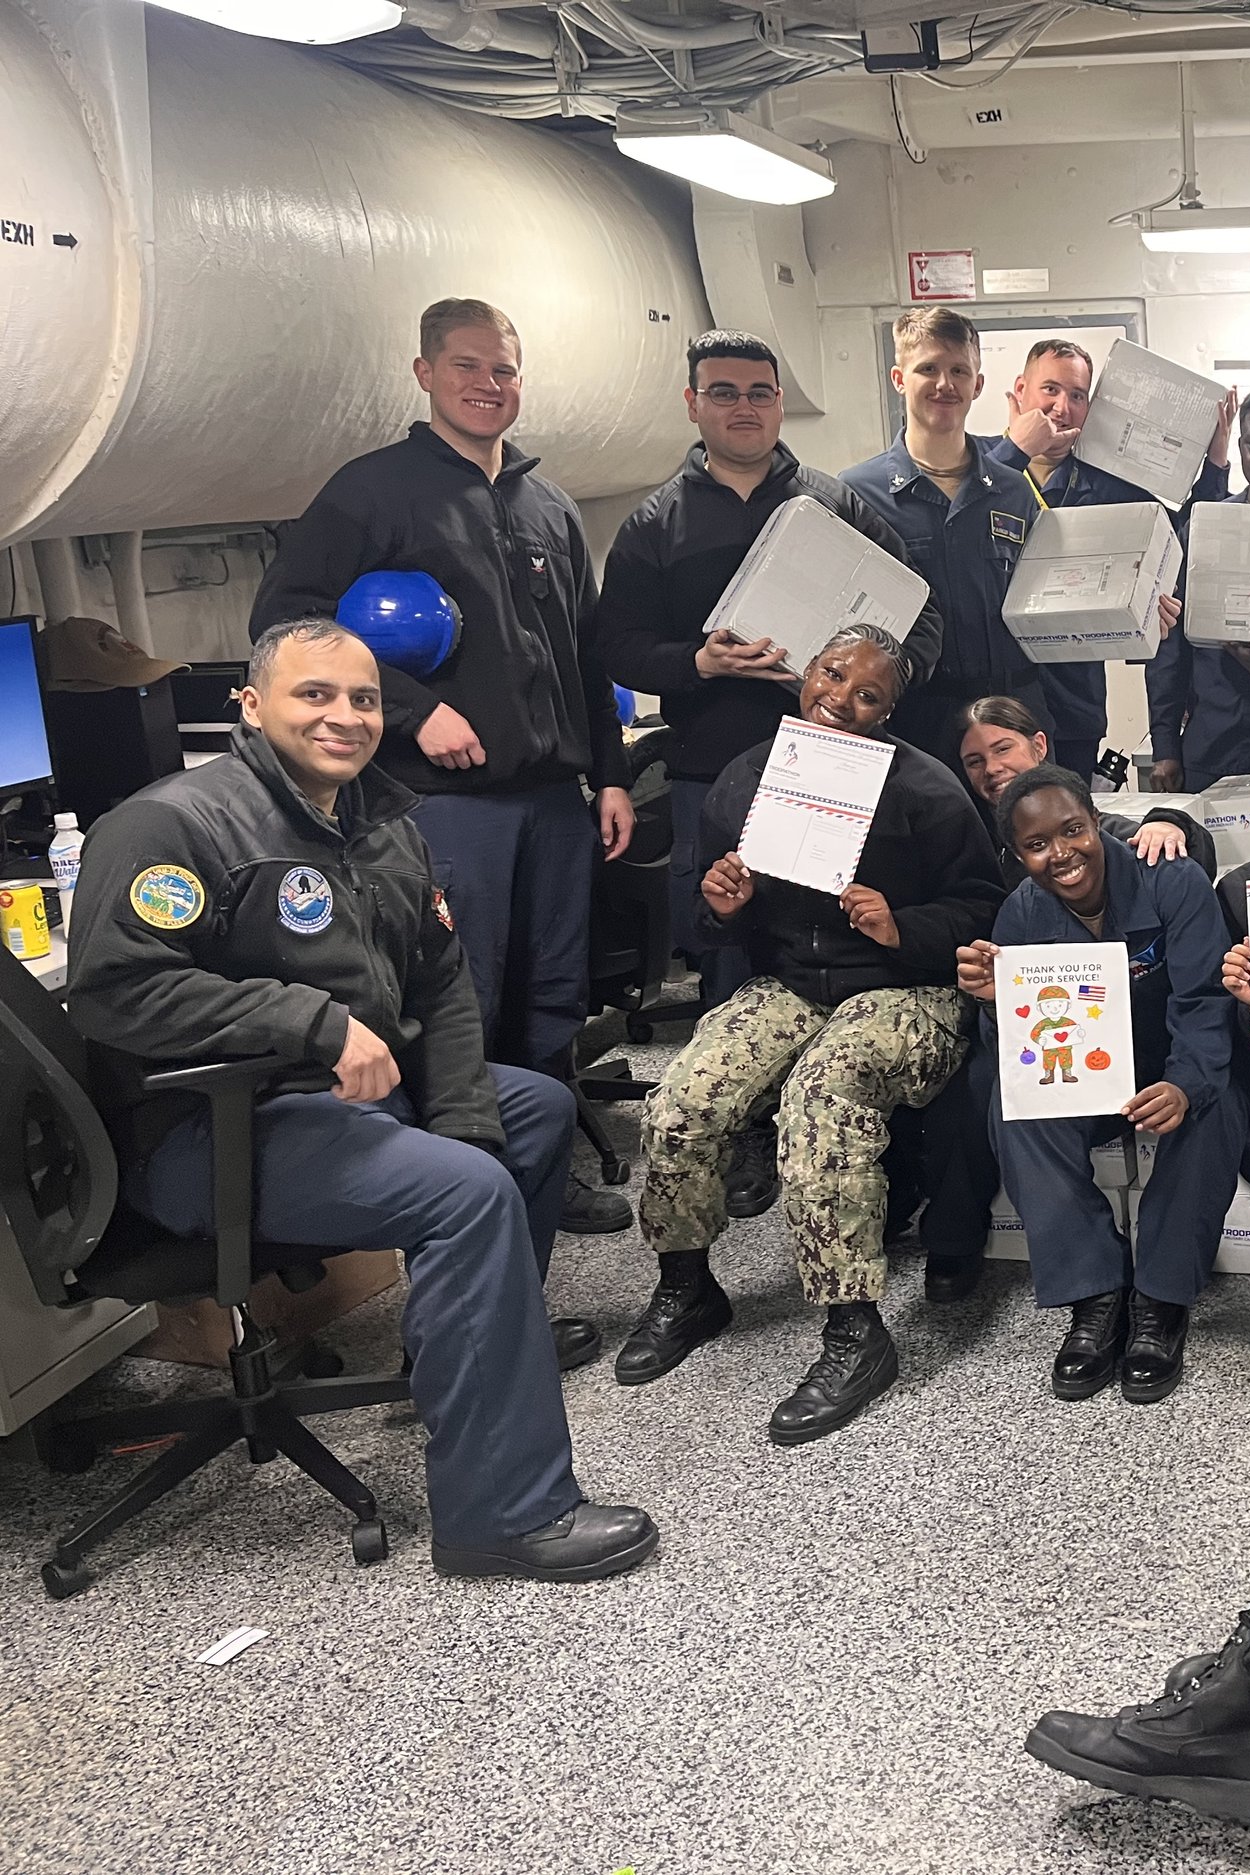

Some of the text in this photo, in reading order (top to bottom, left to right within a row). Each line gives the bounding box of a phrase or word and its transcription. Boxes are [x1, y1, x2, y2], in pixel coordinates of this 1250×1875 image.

[976, 109, 1002, 123] EXH
[1, 219, 34, 246] EXH
[1017, 631, 1133, 642] TROOPATHON TROOPATHON
[1021, 963, 1102, 975] THANK YOU FOR
[1027, 974, 1100, 984] YOUR SERVICE!
